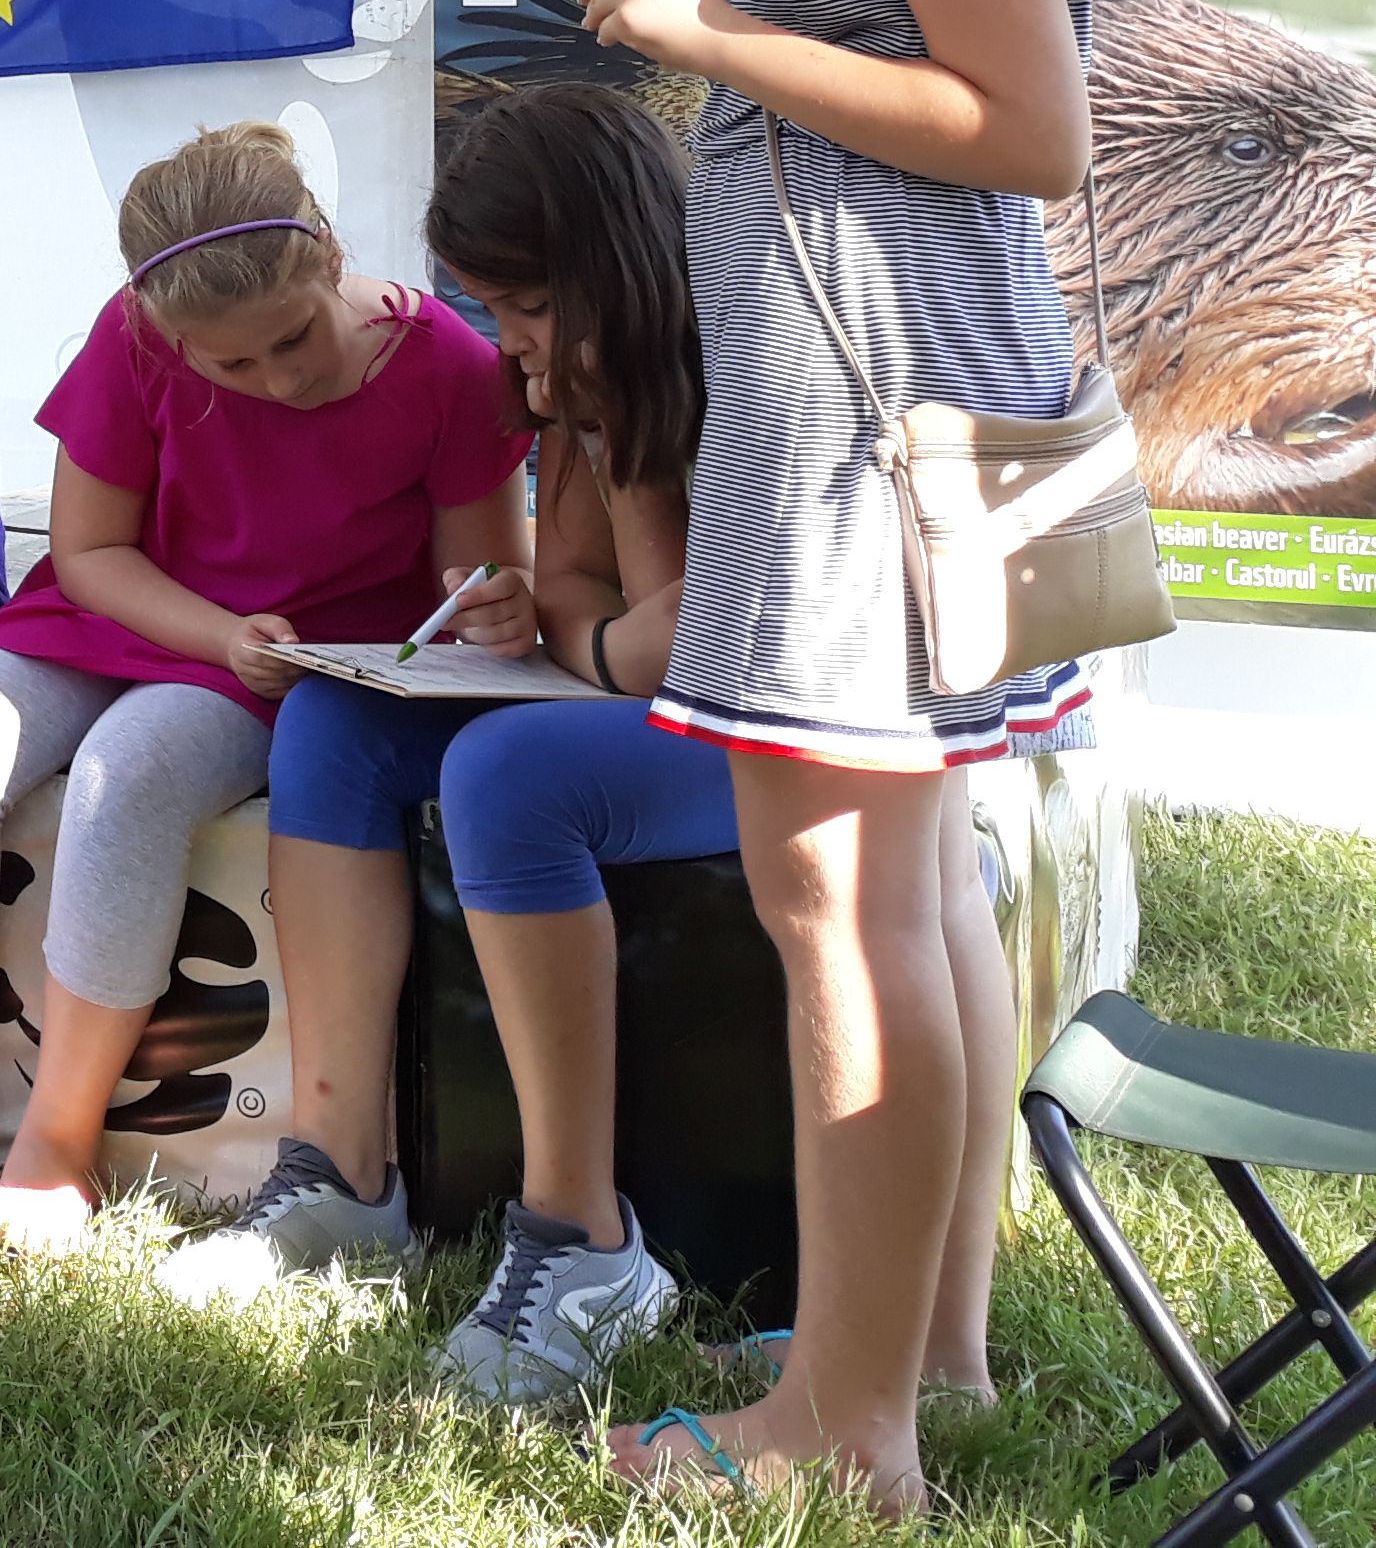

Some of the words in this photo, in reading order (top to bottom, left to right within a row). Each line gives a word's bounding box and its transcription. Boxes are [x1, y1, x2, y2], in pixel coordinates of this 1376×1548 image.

[1152, 520, 1207, 548] asian
[1211, 520, 1290, 551] beaver
[1309, 524, 1376, 557] Euráz
[1159, 554, 1205, 584] abar
[1225, 557, 1317, 591] Castorul
[1337, 563, 1376, 594] Evr
